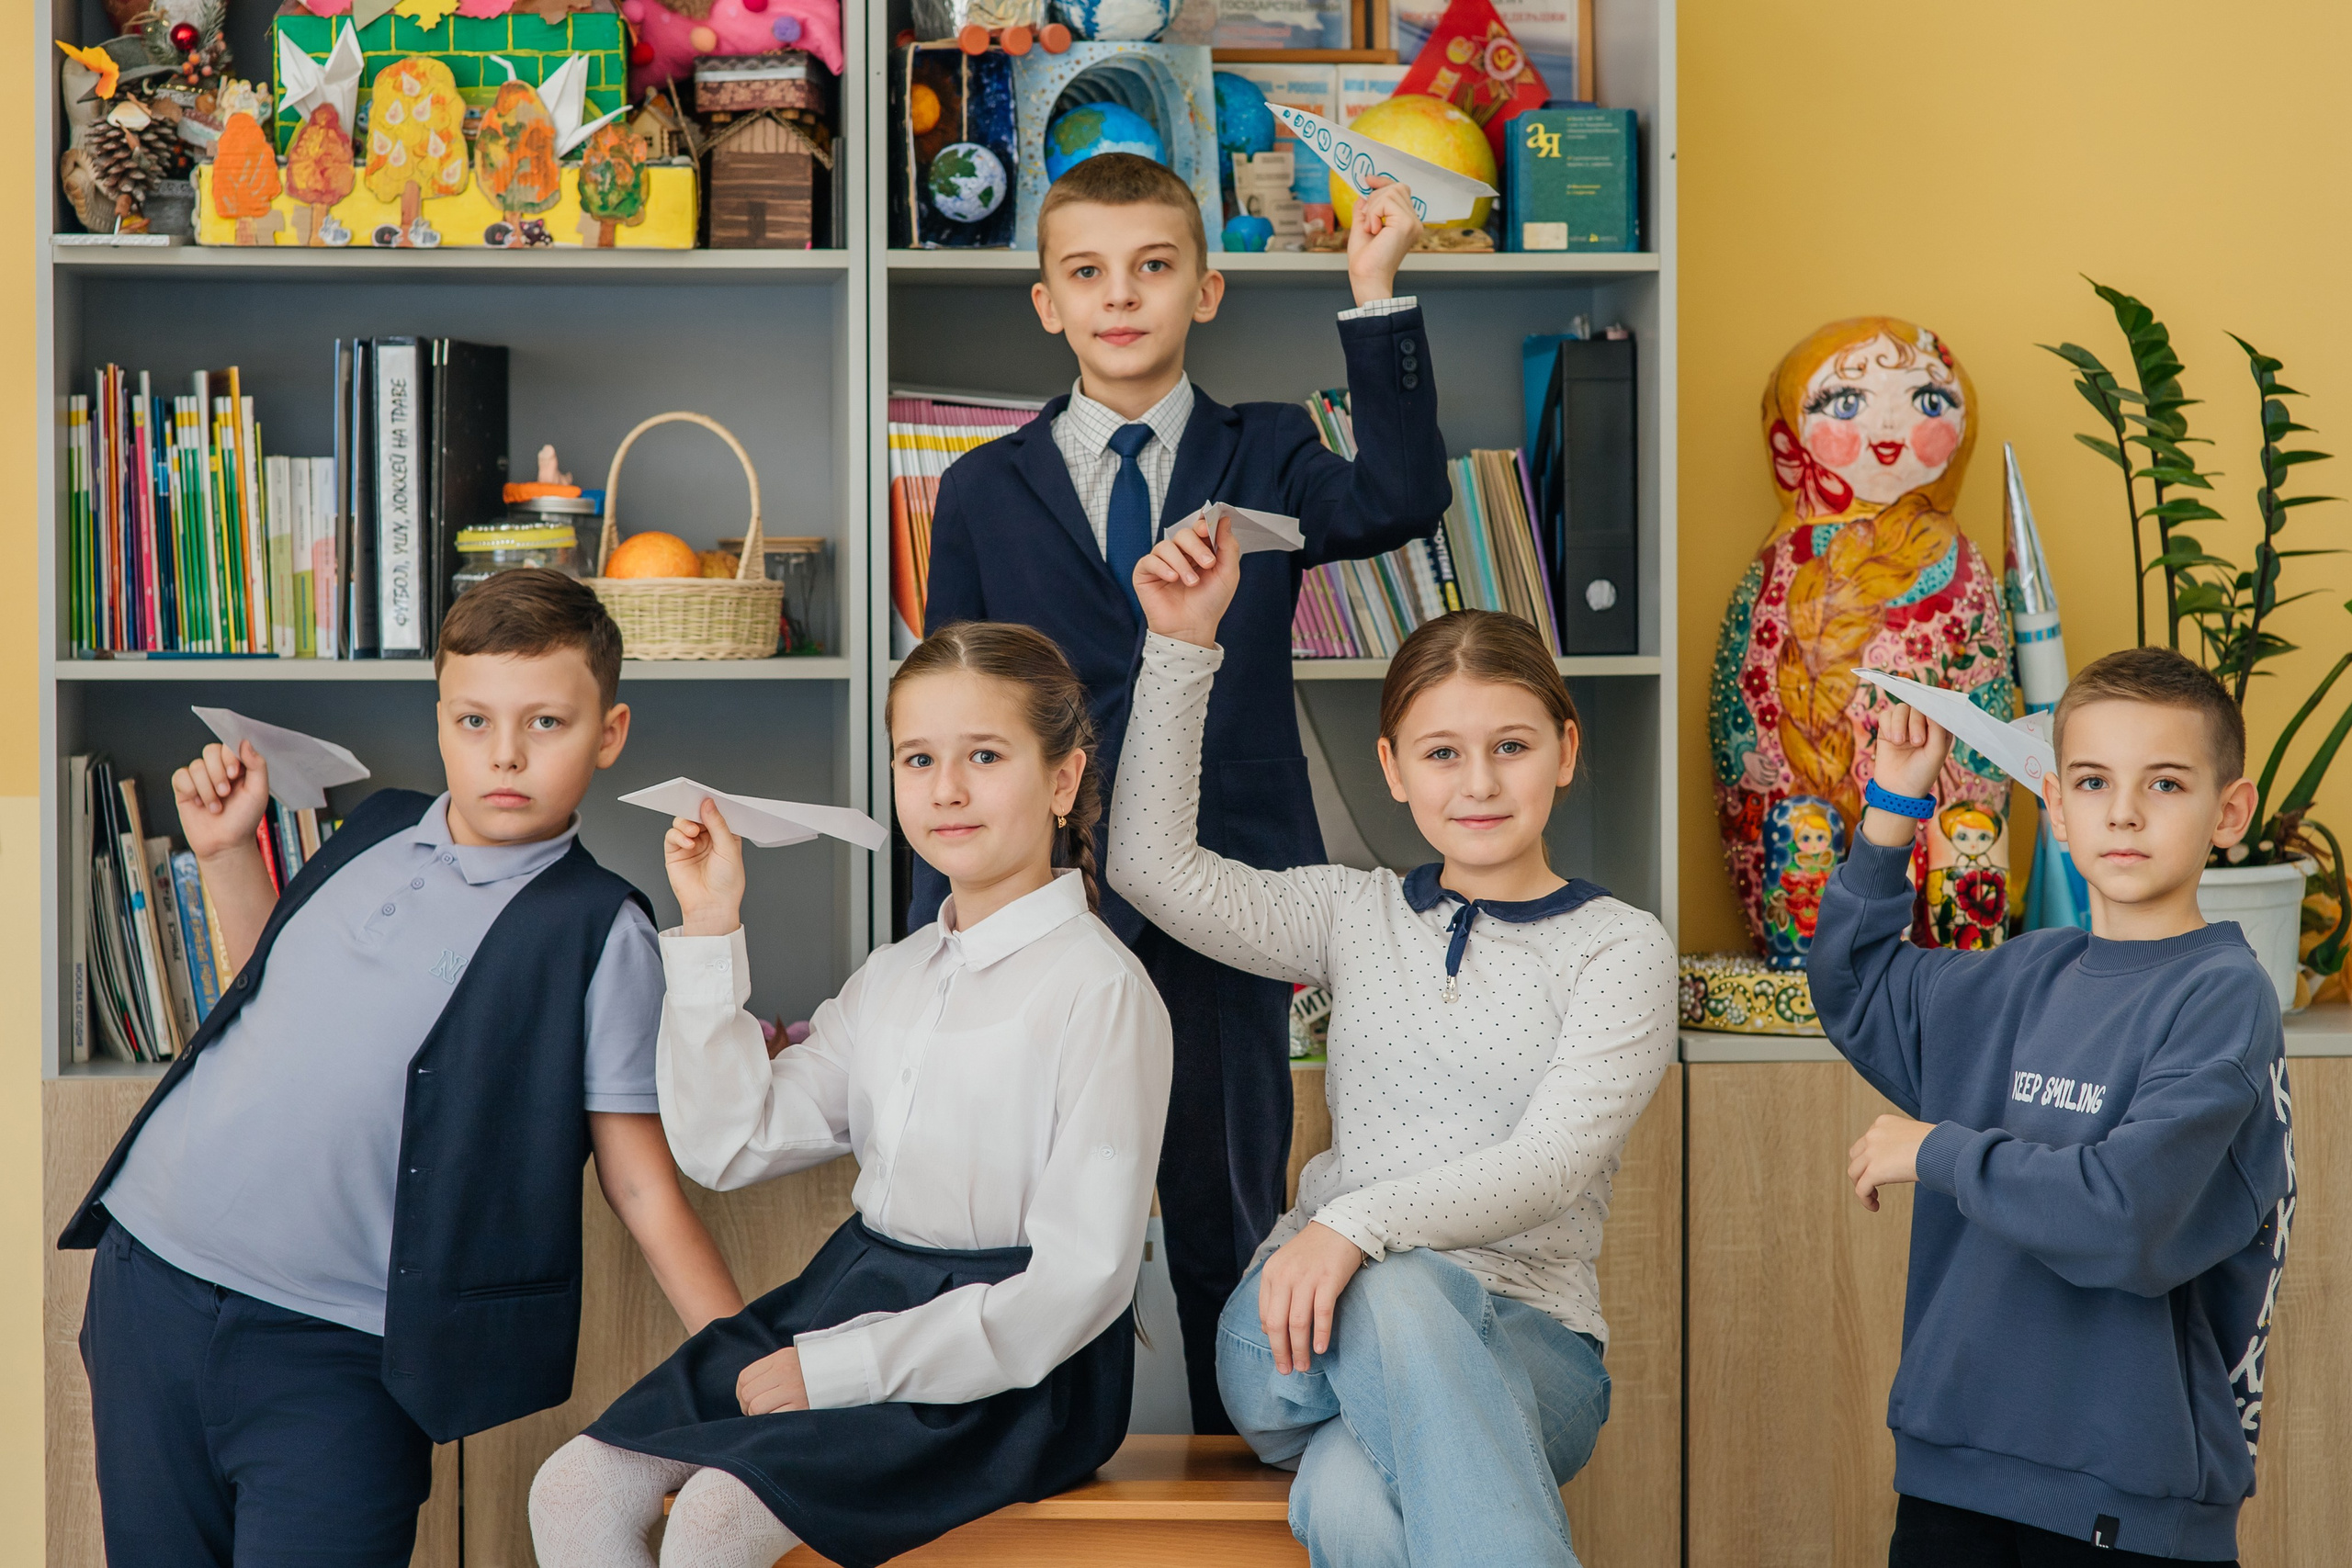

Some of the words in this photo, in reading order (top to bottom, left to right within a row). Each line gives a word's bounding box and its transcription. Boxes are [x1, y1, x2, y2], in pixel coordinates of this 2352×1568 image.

[390, 378, 406, 426] ТРАВЕ
[391, 428, 407, 449] НА
[390, 453, 408, 514] ХОККЕЙ
[393, 519, 411, 556] УШУ,
[391, 561, 411, 626] ФУТБОЛ,
[428, 948, 469, 985] N
[2011, 1070, 2043, 1103] KEEP
[2041, 1076, 2107, 1115] SMILING
